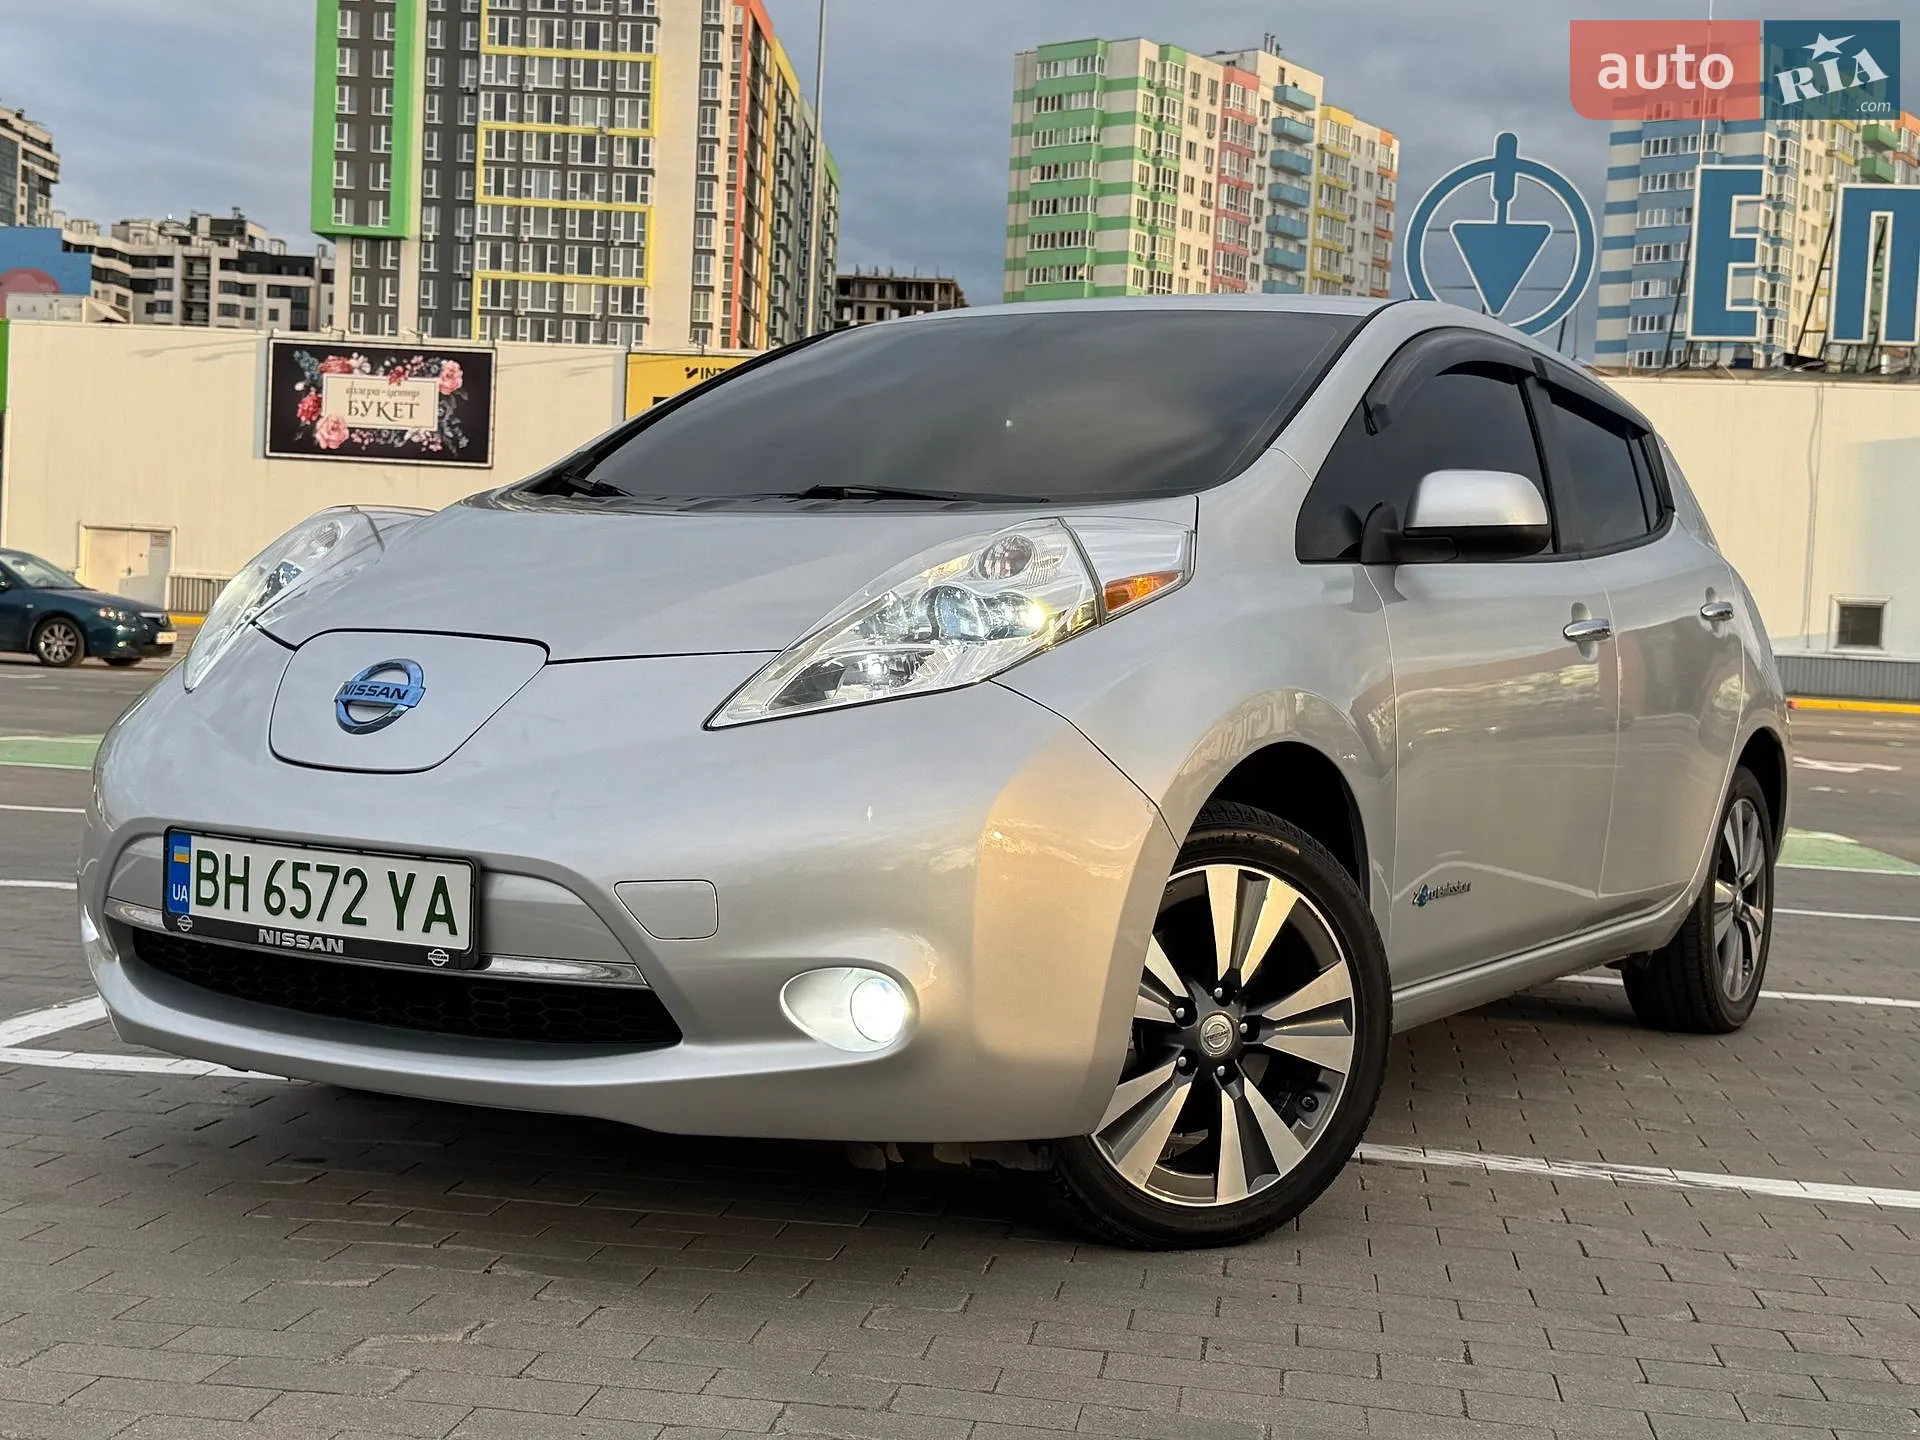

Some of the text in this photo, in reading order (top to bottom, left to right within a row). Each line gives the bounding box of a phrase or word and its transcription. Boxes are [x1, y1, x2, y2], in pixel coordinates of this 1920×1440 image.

[348, 400, 420, 422] БУКЕТ
[341, 684, 409, 700] NISSAN
[172, 883, 189, 902] UA
[195, 849, 458, 936] BH 6572 YA
[258, 928, 344, 954] NISSAN
